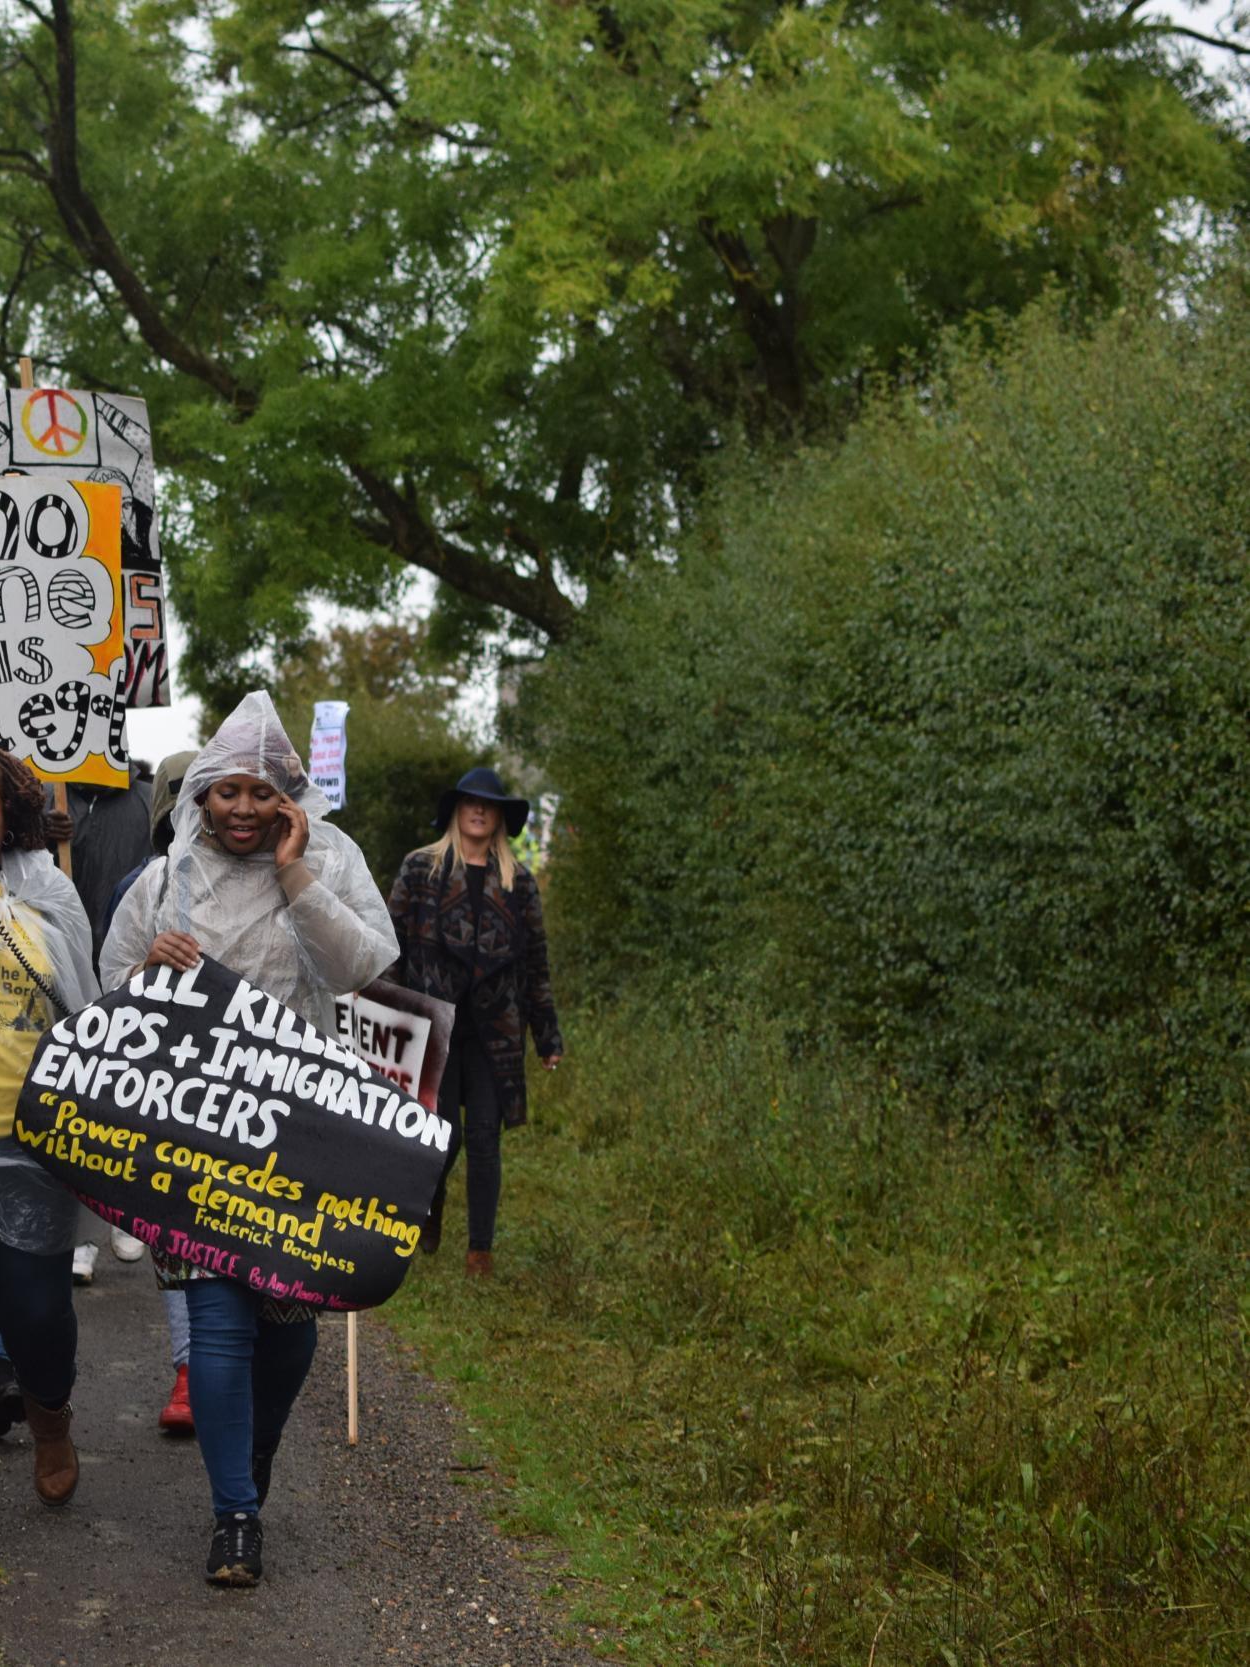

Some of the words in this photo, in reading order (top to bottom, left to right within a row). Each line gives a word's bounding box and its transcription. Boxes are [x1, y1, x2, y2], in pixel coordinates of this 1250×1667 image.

[31, 1043, 291, 1149] ENFORCERS
[200, 1027, 452, 1152] IMMIGRATION
[16, 1120, 138, 1182] without
[150, 1172, 172, 1194] a
[155, 1142, 304, 1201] concedes
[317, 1192, 421, 1257] nothing
[132, 1217, 162, 1249] FOR
[166, 1229, 242, 1278] JUSTICE
[250, 1266, 266, 1290] By
[195, 1207, 275, 1248] Frederick
[282, 1239, 356, 1274] Douglass
